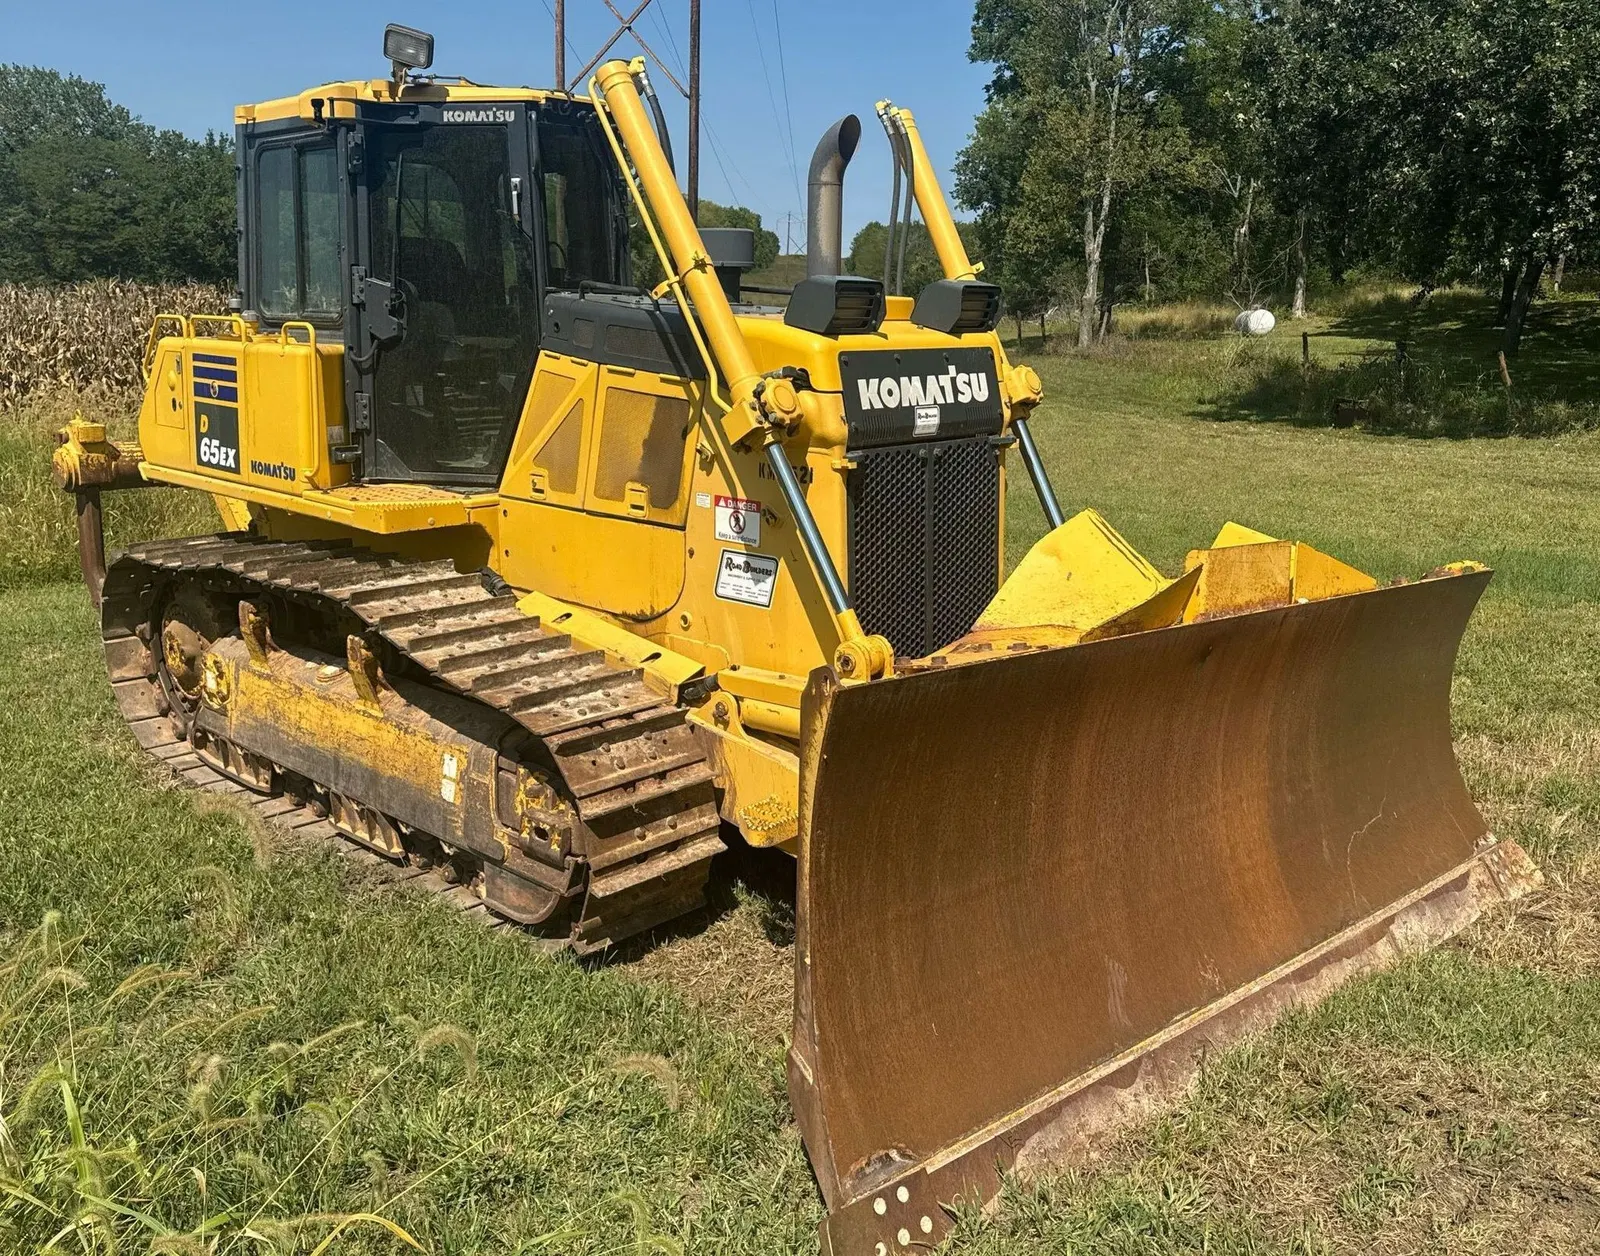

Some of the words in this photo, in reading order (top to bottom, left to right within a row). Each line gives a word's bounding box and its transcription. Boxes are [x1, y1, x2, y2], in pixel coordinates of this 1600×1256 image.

[443, 107, 515, 122] KOMATSU
[857, 365, 989, 410] KOMATSU
[199, 414, 209, 433] D
[200, 437, 237, 469] 65EX
[250, 460, 296, 482] KOMATSU
[727, 499, 757, 511] DANGER
